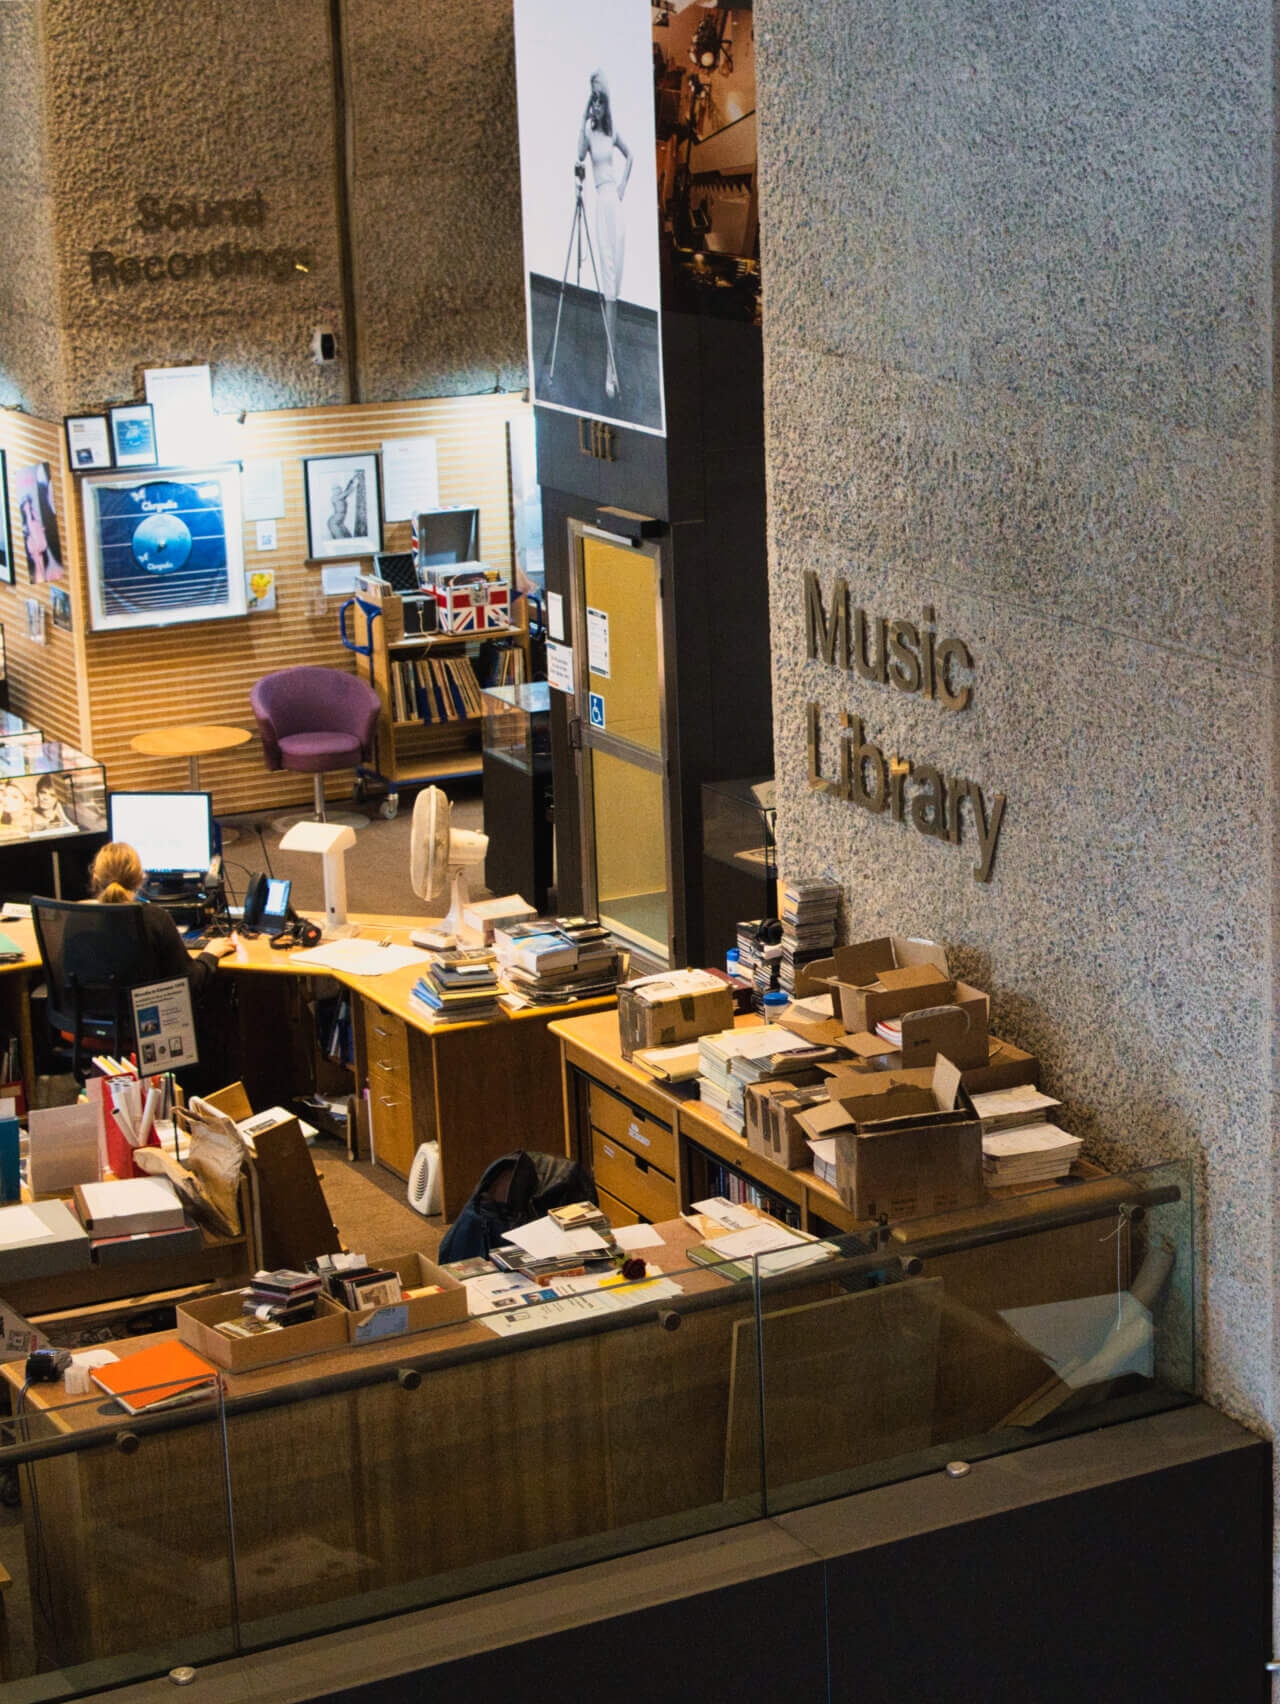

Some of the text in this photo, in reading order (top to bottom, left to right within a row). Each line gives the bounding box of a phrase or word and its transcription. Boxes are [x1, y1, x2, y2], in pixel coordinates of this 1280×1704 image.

[137, 188, 268, 233] Sound
[88, 242, 312, 288] Recordings
[577, 417, 615, 463] Lift
[803, 568, 976, 713] Music
[805, 700, 1008, 884] Library
